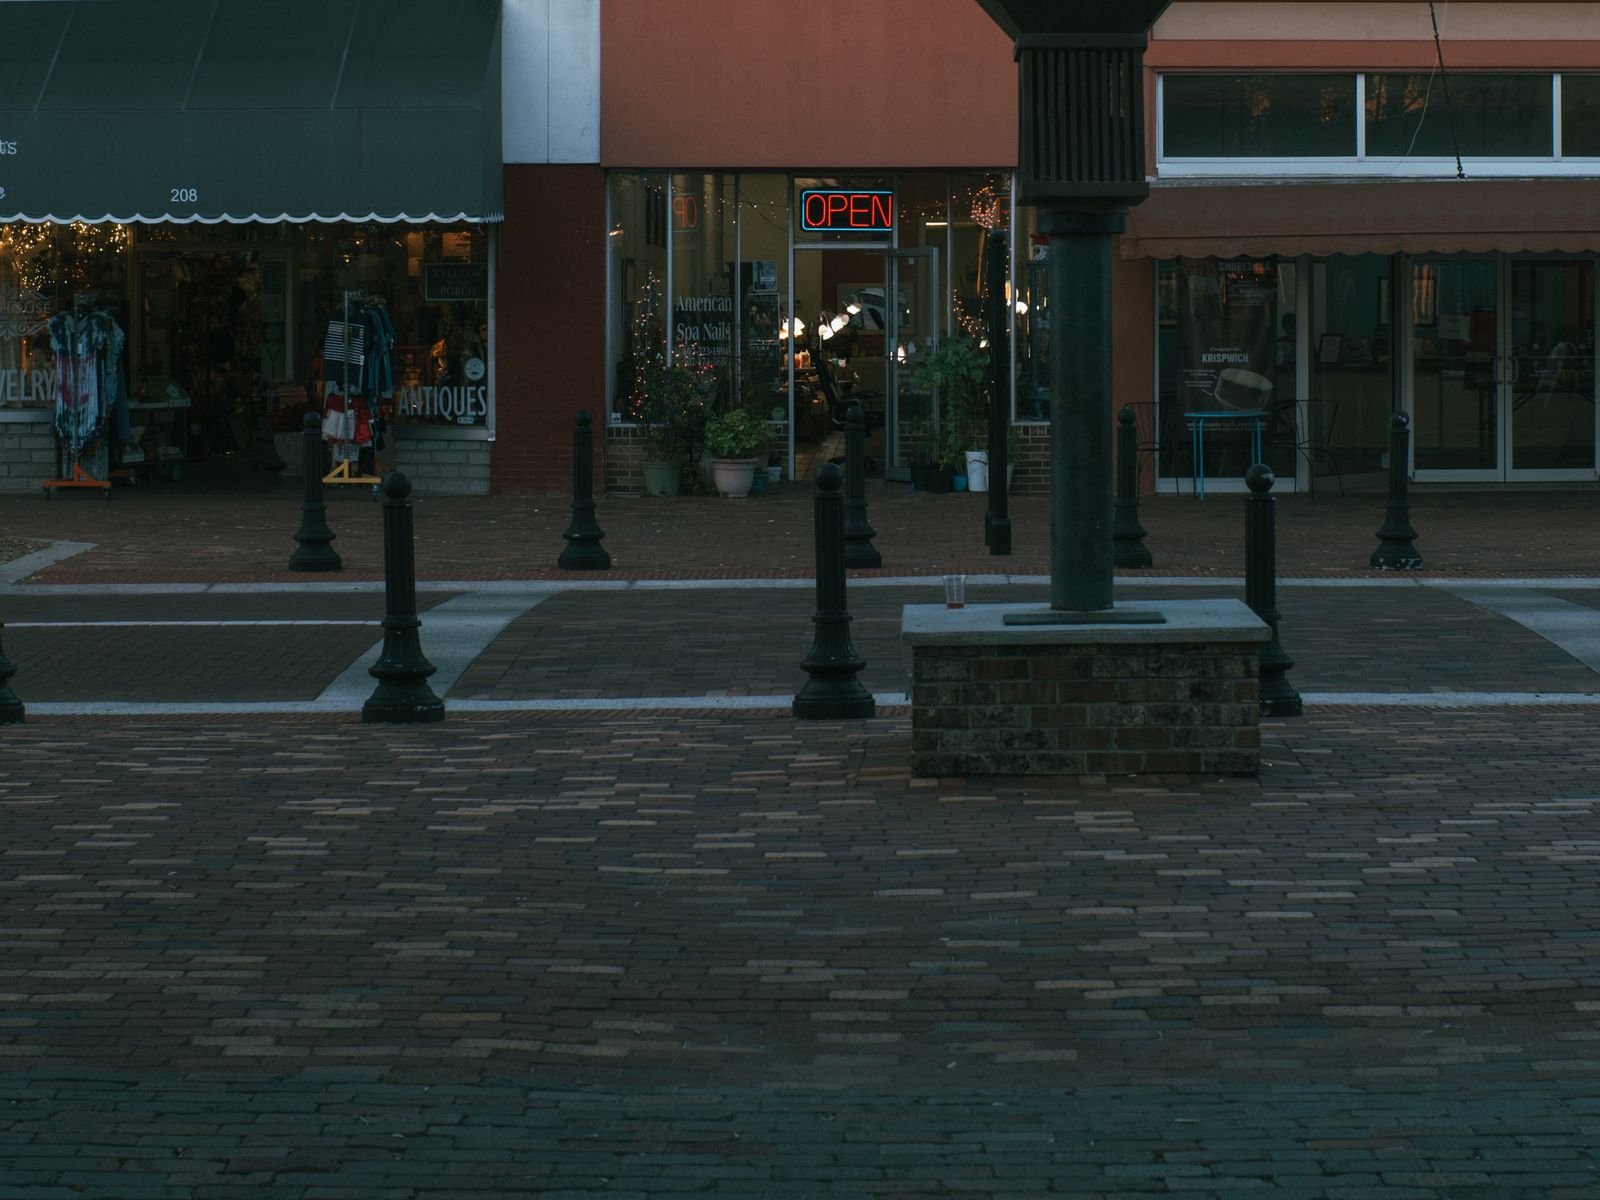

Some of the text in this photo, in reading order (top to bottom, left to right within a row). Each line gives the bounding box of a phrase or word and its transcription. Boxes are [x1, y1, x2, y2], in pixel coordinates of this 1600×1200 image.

[170, 188, 198, 202] 208
[805, 194, 892, 227] OPEN
[0, 303, 51, 314] HOUSE
[675, 293, 732, 311] American
[677, 322, 731, 345] Spa Nails
[1202, 353, 1248, 363] KRISPWICH
[397, 386, 487, 421] ANTIQUES
